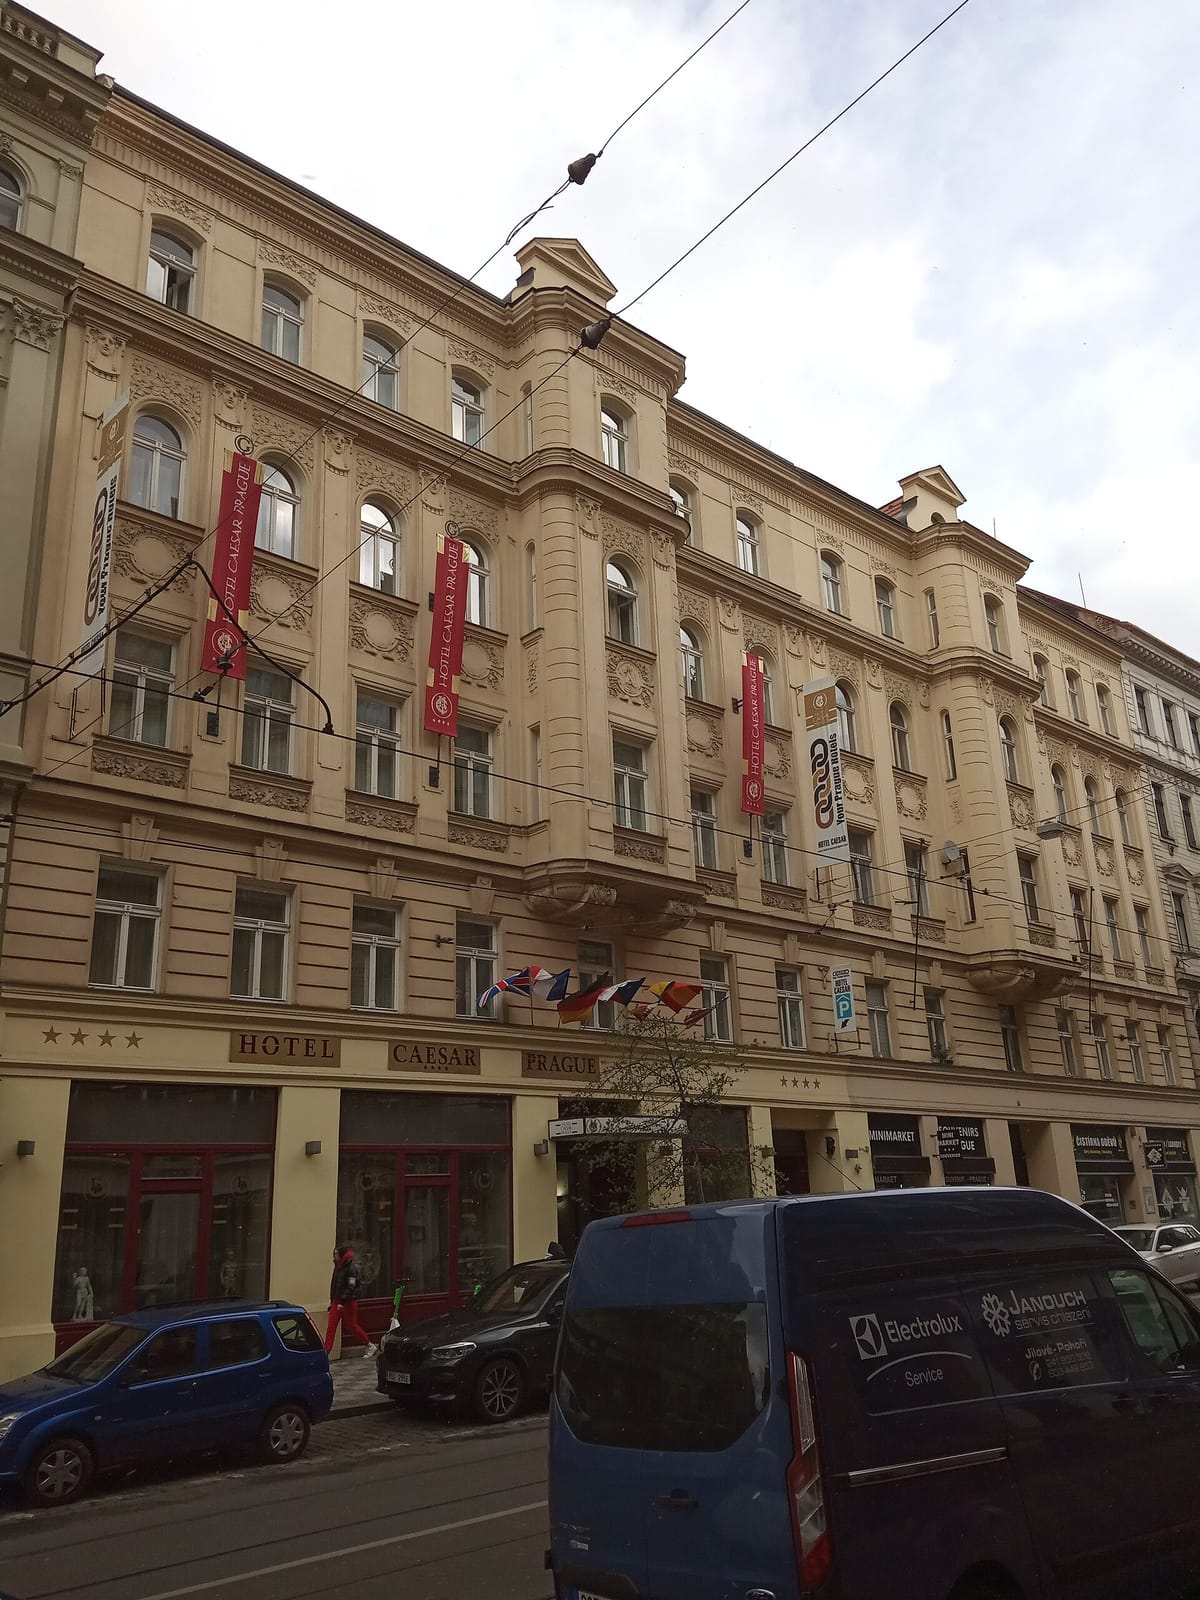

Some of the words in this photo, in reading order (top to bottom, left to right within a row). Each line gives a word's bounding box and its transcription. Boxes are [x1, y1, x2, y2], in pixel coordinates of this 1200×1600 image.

[234, 462, 251, 515] PRAGUE
[228, 519, 243, 571] CAESAR
[447, 543, 459, 592] PRAGUE
[222, 573, 237, 624] HOTEL
[442, 593, 455, 643] CAESAR
[439, 646, 450, 687] HOTEL
[750, 659, 758, 698] PRAGUE
[751, 738, 760, 775] HOTEL
[829, 733, 839, 765] Hotels
[832, 766, 842, 801] Prague
[836, 802, 845, 826] Your
[818, 839, 830, 848] HOTEL
[830, 835, 847, 845] CAESAR
[839, 1001, 850, 1017] P
[238, 1033, 336, 1061] HOTEL
[392, 1044, 479, 1068] CAESAR
[527, 1053, 597, 1074] PRAGUE
[869, 1130, 915, 1142] MINIMARKET
[960, 1140, 976, 1151] GUE
[1009, 1290, 1087, 1315] JANOUCH
[884, 1313, 963, 1343] Electrolux
[1015, 1315, 1049, 1331] servis
[904, 1367, 943, 1387] Service
